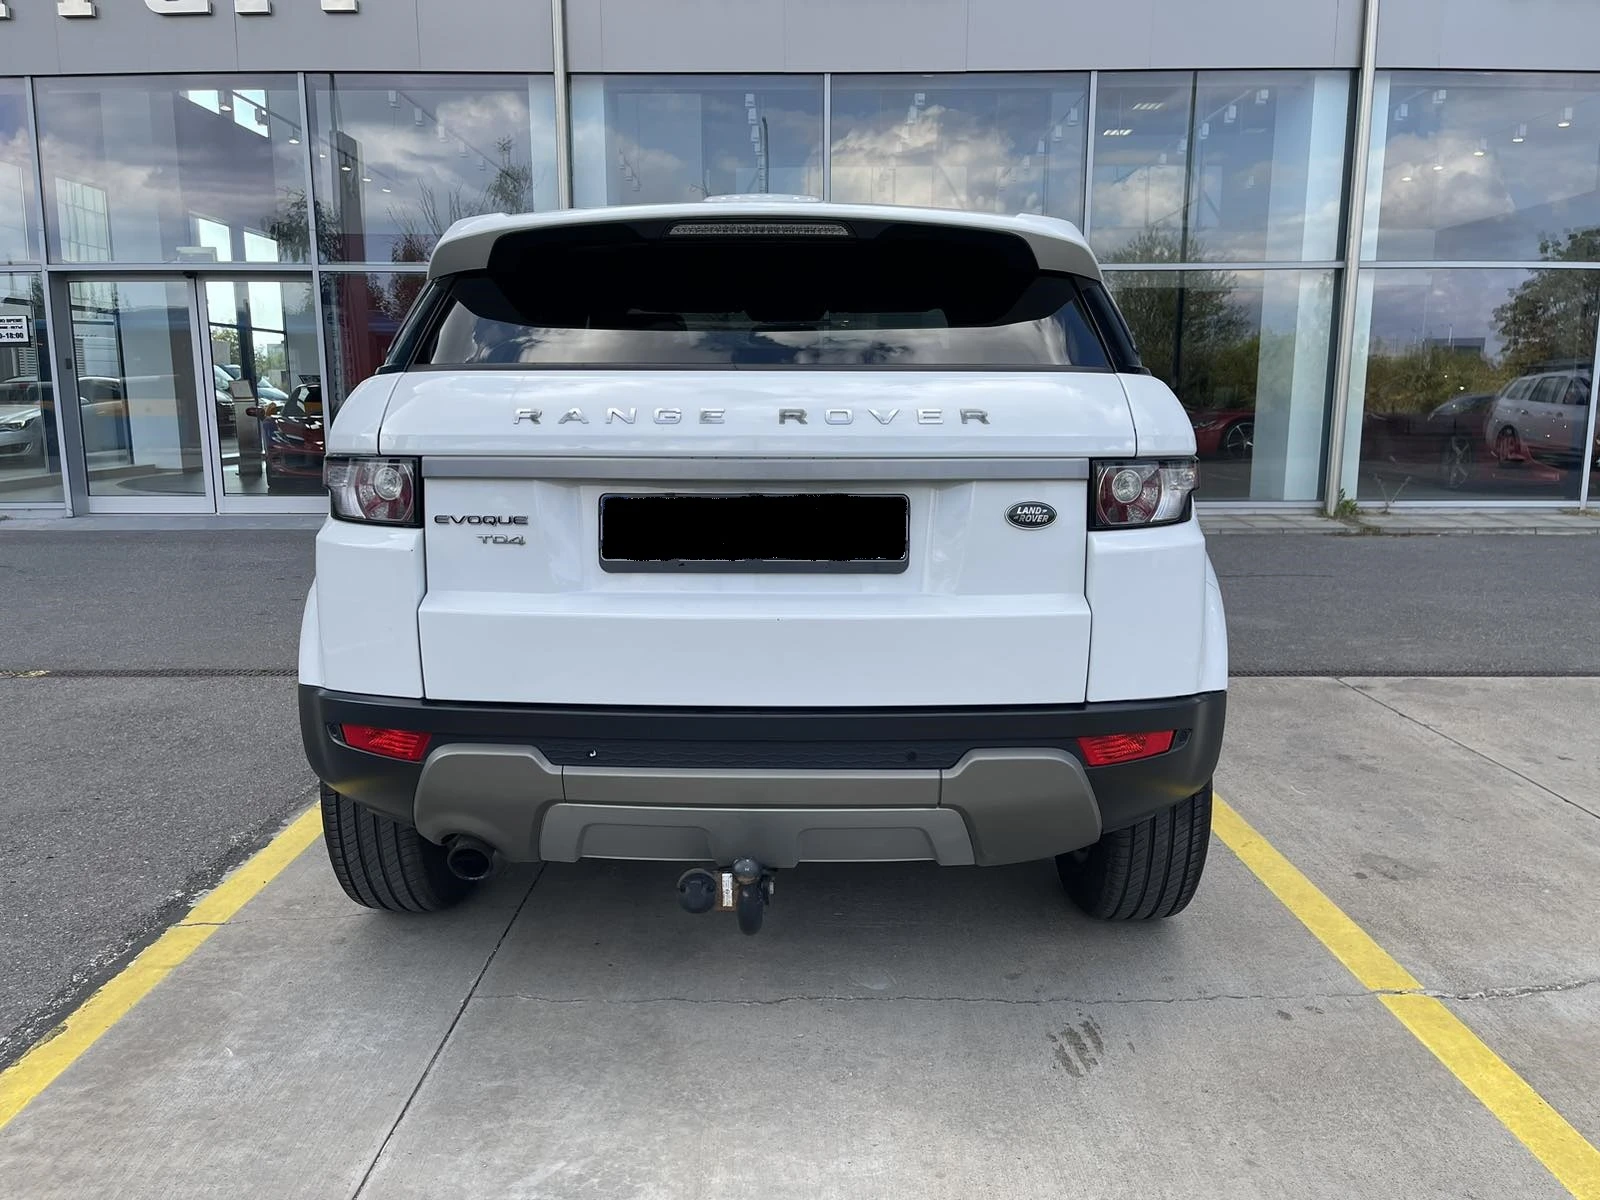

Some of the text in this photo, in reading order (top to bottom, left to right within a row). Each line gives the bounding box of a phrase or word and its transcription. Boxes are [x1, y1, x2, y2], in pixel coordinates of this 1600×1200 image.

[513, 407, 991, 425] RANGE ROVER
[434, 515, 528, 526] EVOQUE
[476, 535, 526, 546] TD4
